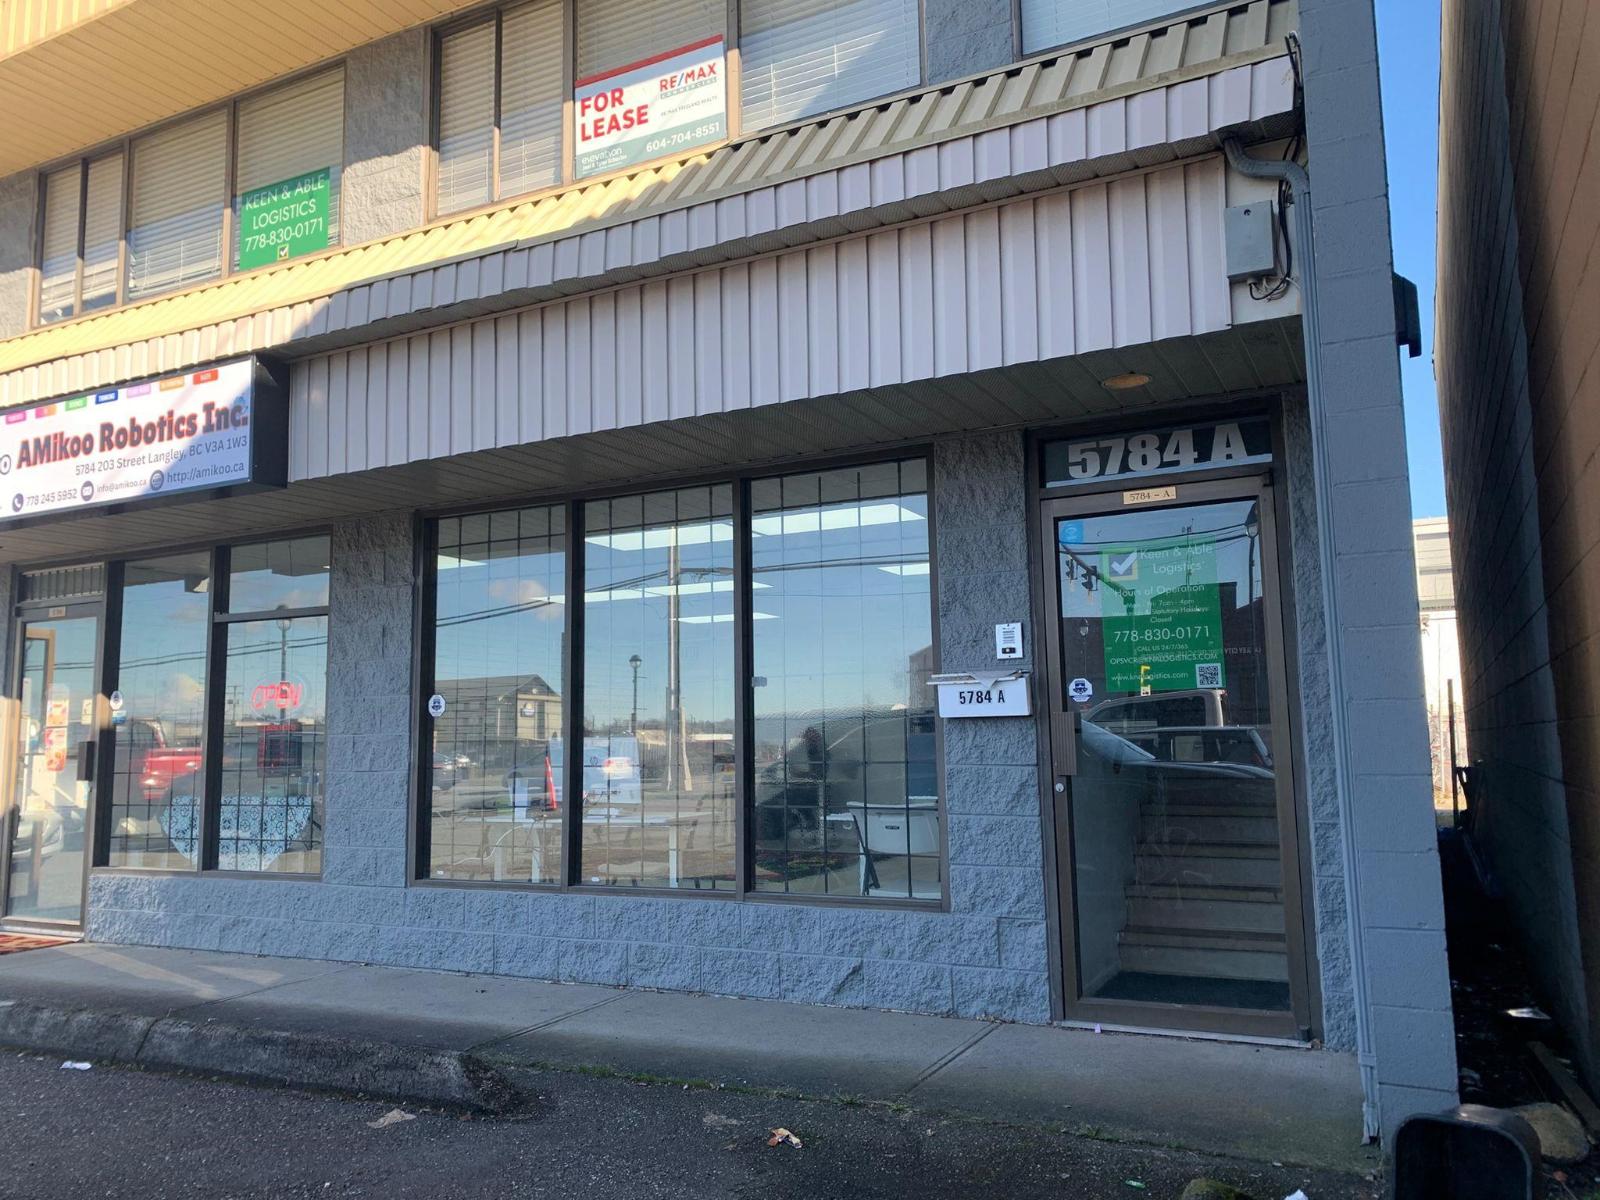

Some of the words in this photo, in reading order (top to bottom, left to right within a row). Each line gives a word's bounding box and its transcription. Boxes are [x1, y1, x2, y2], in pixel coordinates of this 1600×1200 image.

[659, 63, 717, 92] RE/MAX
[580, 88, 624, 117] FOR
[580, 105, 649, 142] LEASE
[645, 122, 720, 152] 604-704-8551
[246, 190, 277, 210] KEEN
[281, 185, 291, 200] &
[295, 175, 325, 196] ABLE
[252, 198, 317, 230] LOGISTICS
[245, 217, 323, 252] 778-830-0171
[16, 431, 94, 469] AMikoo
[99, 410, 198, 453] Robotics
[202, 401, 248, 435] Inc.
[75, 459, 96, 476] 5784
[97, 456, 115, 472] 203
[116, 452, 146, 469] Street
[148, 446, 188, 466] Langley,
[189, 443, 203, 457] BC
[205, 440, 224, 453] V3A
[226, 436, 248, 451] 1W3
[1068, 428, 1198, 479] 5784
[1210, 423, 1248, 462] A
[96, 478, 147, 494] info@amikoo.ca
[167, 461, 245, 484] http://amikoo.ca
[26, 494, 40, 507] 778
[40, 491, 55, 504] 245
[57, 488, 78, 502] 5952
[1129, 491, 1151, 502] 5784
[1140, 548, 1169, 560] Keen
[1173, 547, 1181, 556] &
[1187, 543, 1213, 555] Able
[1153, 560, 1202, 575] Logistics
[1156, 583, 1205, 596] Operation
[1114, 626, 1210, 643] 778-830-0171
[251, 682, 304, 710] OPEN
[959, 690, 992, 705] 5784
[998, 690, 1005, 704] A
